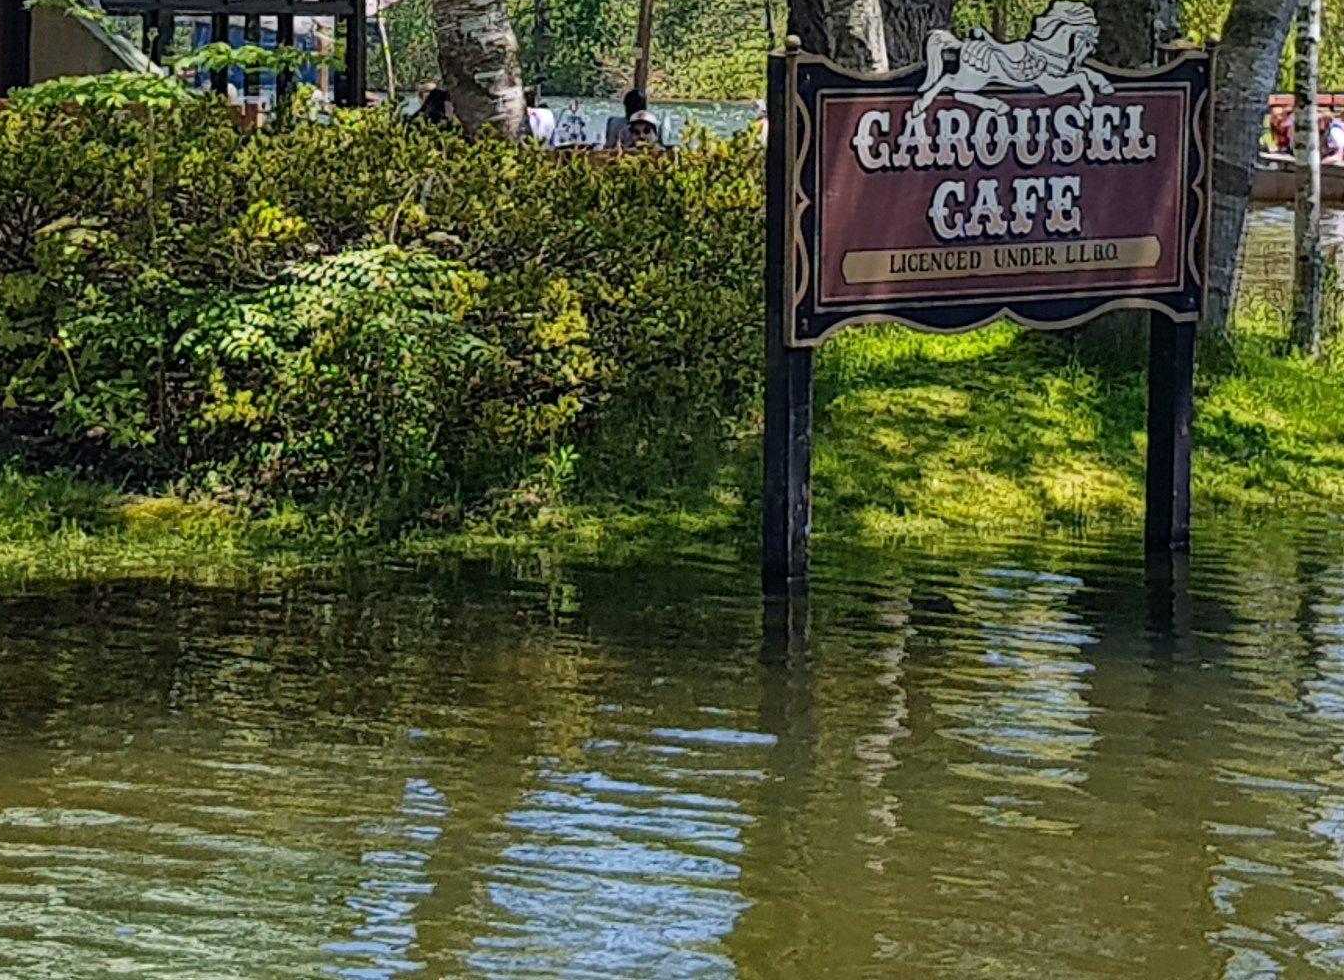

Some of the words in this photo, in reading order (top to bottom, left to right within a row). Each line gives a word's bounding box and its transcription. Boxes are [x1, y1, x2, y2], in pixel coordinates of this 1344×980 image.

[853, 104, 1156, 170] CAROUSEL
[928, 175, 1082, 240] CAFE
[889, 251, 981, 274] LICENCED
[994, 246, 1057, 268] UNDER
